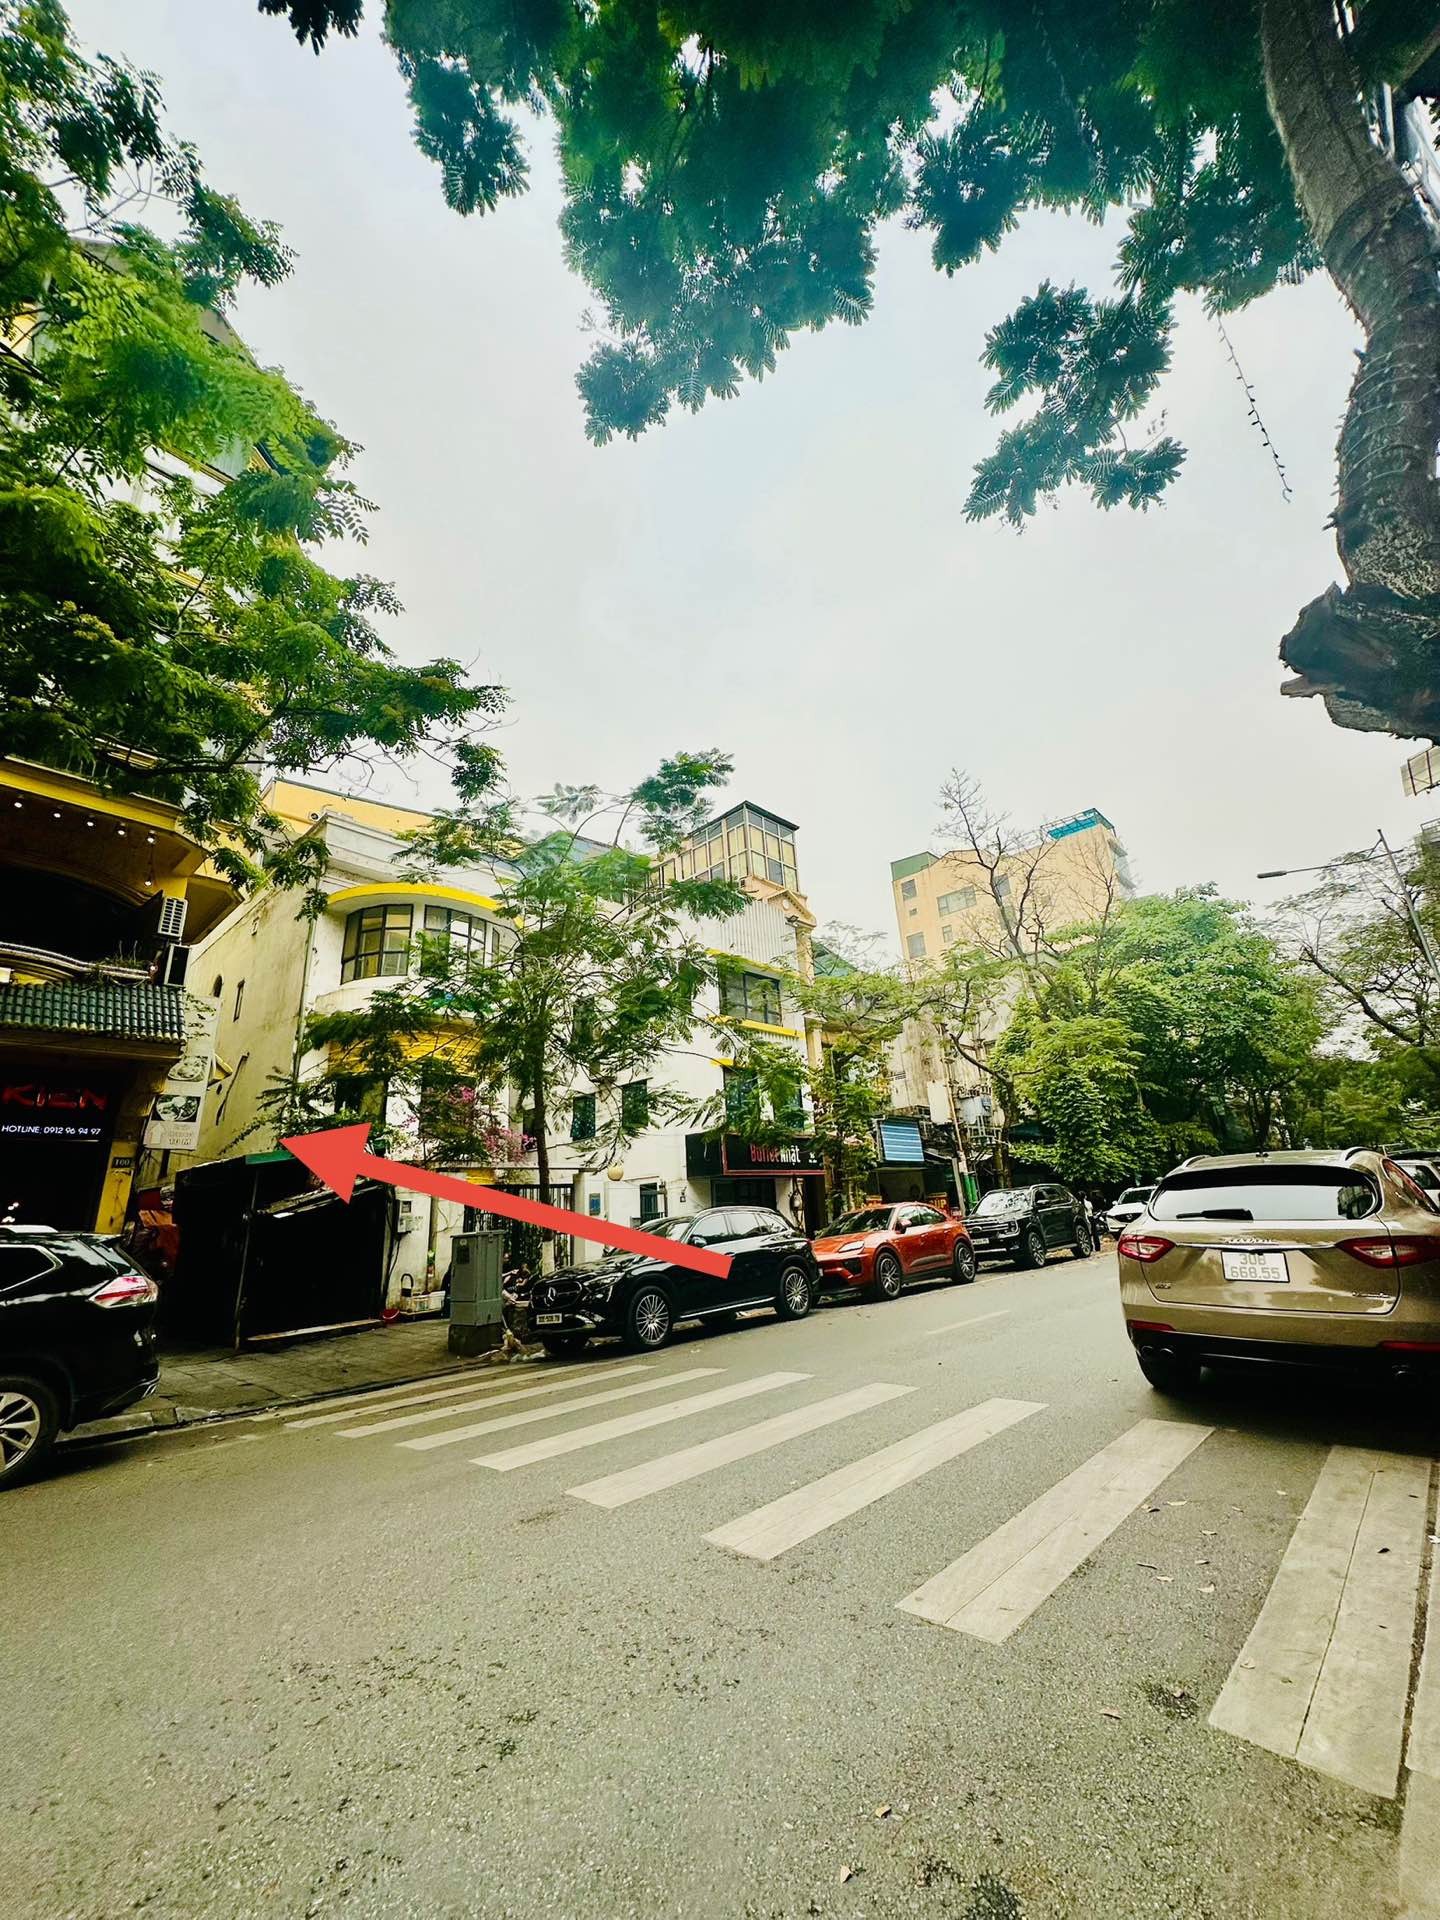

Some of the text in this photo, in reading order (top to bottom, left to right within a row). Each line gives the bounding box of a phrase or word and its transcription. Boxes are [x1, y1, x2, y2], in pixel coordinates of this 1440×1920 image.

[43, 1126, 64, 1134] 0912
[65, 1127, 76, 1135] 96
[90, 1128, 101, 1136] 97
[1230, 1266, 1281, 1280] 668.55
